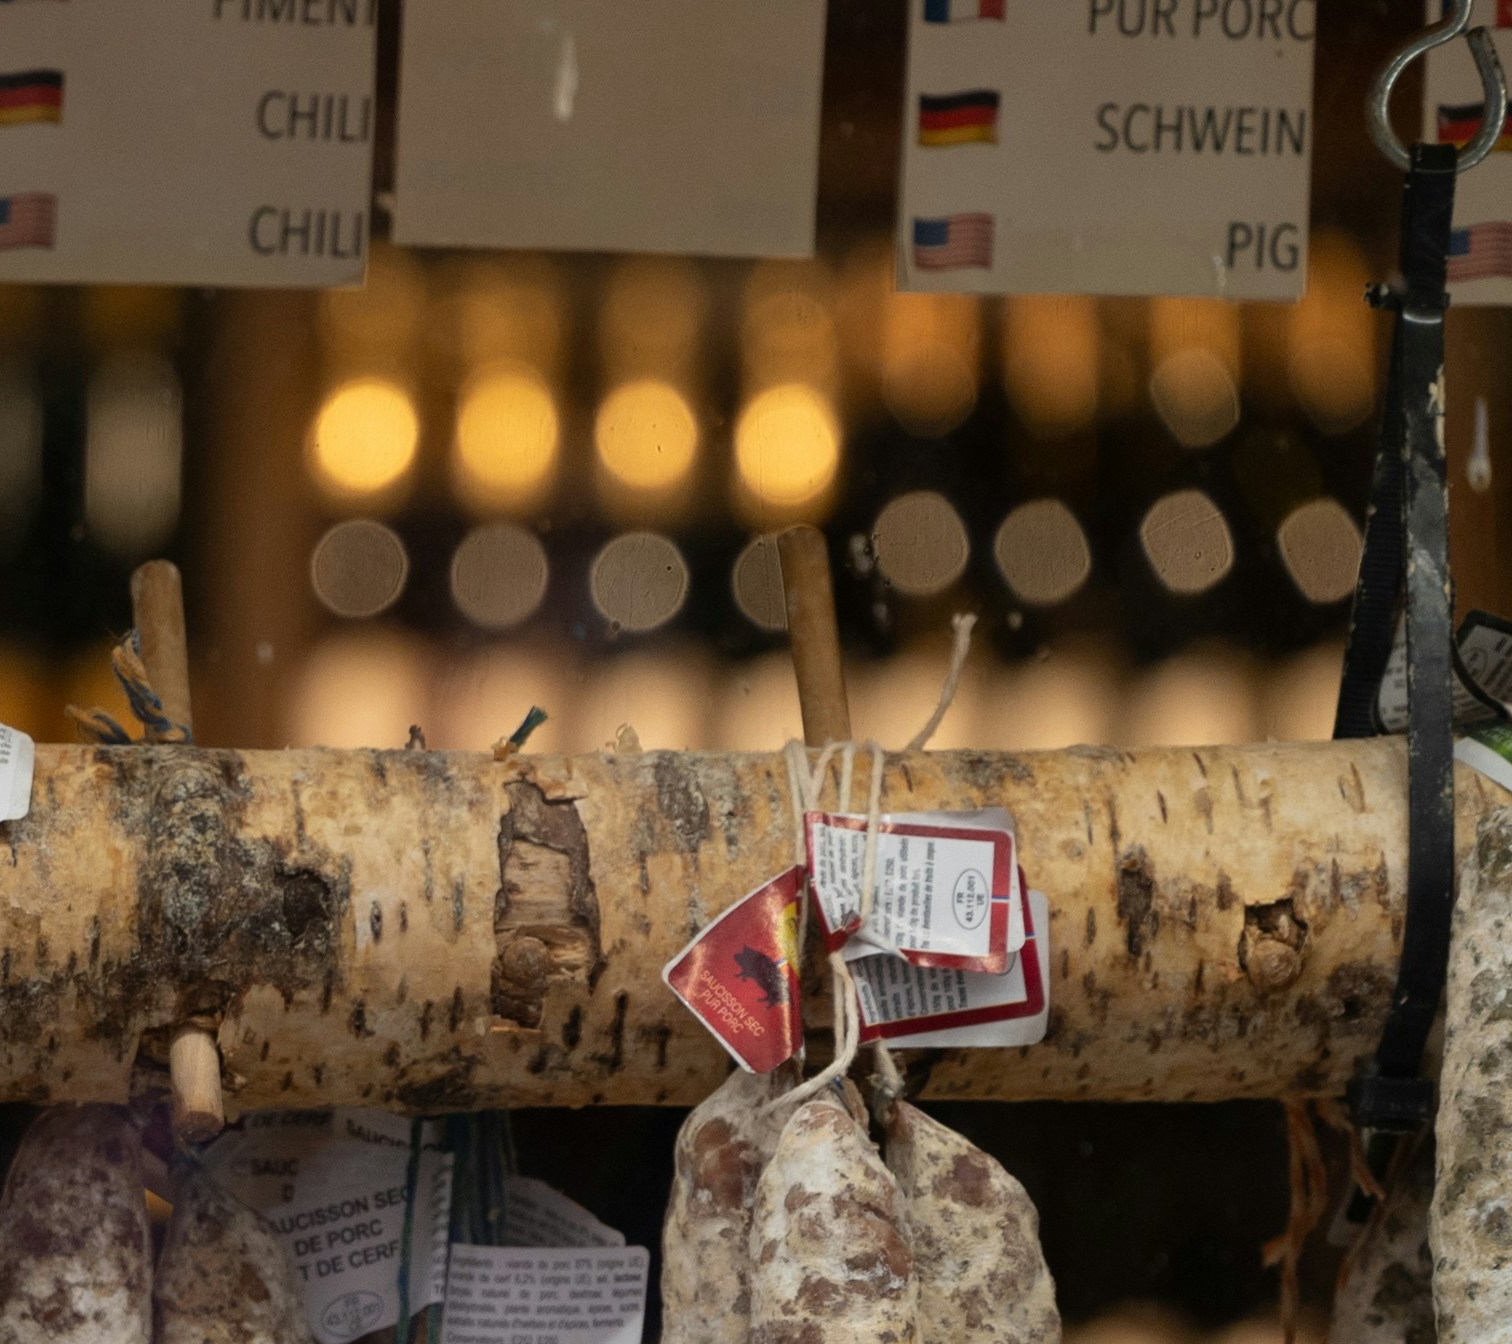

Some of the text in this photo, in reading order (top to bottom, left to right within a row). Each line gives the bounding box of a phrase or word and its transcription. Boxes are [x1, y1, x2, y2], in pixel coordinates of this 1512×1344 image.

[1087, 0, 1315, 44] PUR PORC
[255, 89, 373, 144] CHILI
[1094, 101, 1307, 158] SCHWEIN
[247, 205, 365, 260] CHILI
[1224, 221, 1301, 273] PIG
[955, 891, 964, 904] FR
[699, 969, 765, 1037] SAUCISSON SEC
[699, 989, 744, 1034] PUR PORC
[268, 1195, 370, 1235] AUCISSON
[293, 1219, 384, 1257] DE PORC
[315, 1239, 401, 1278] DE CERF
